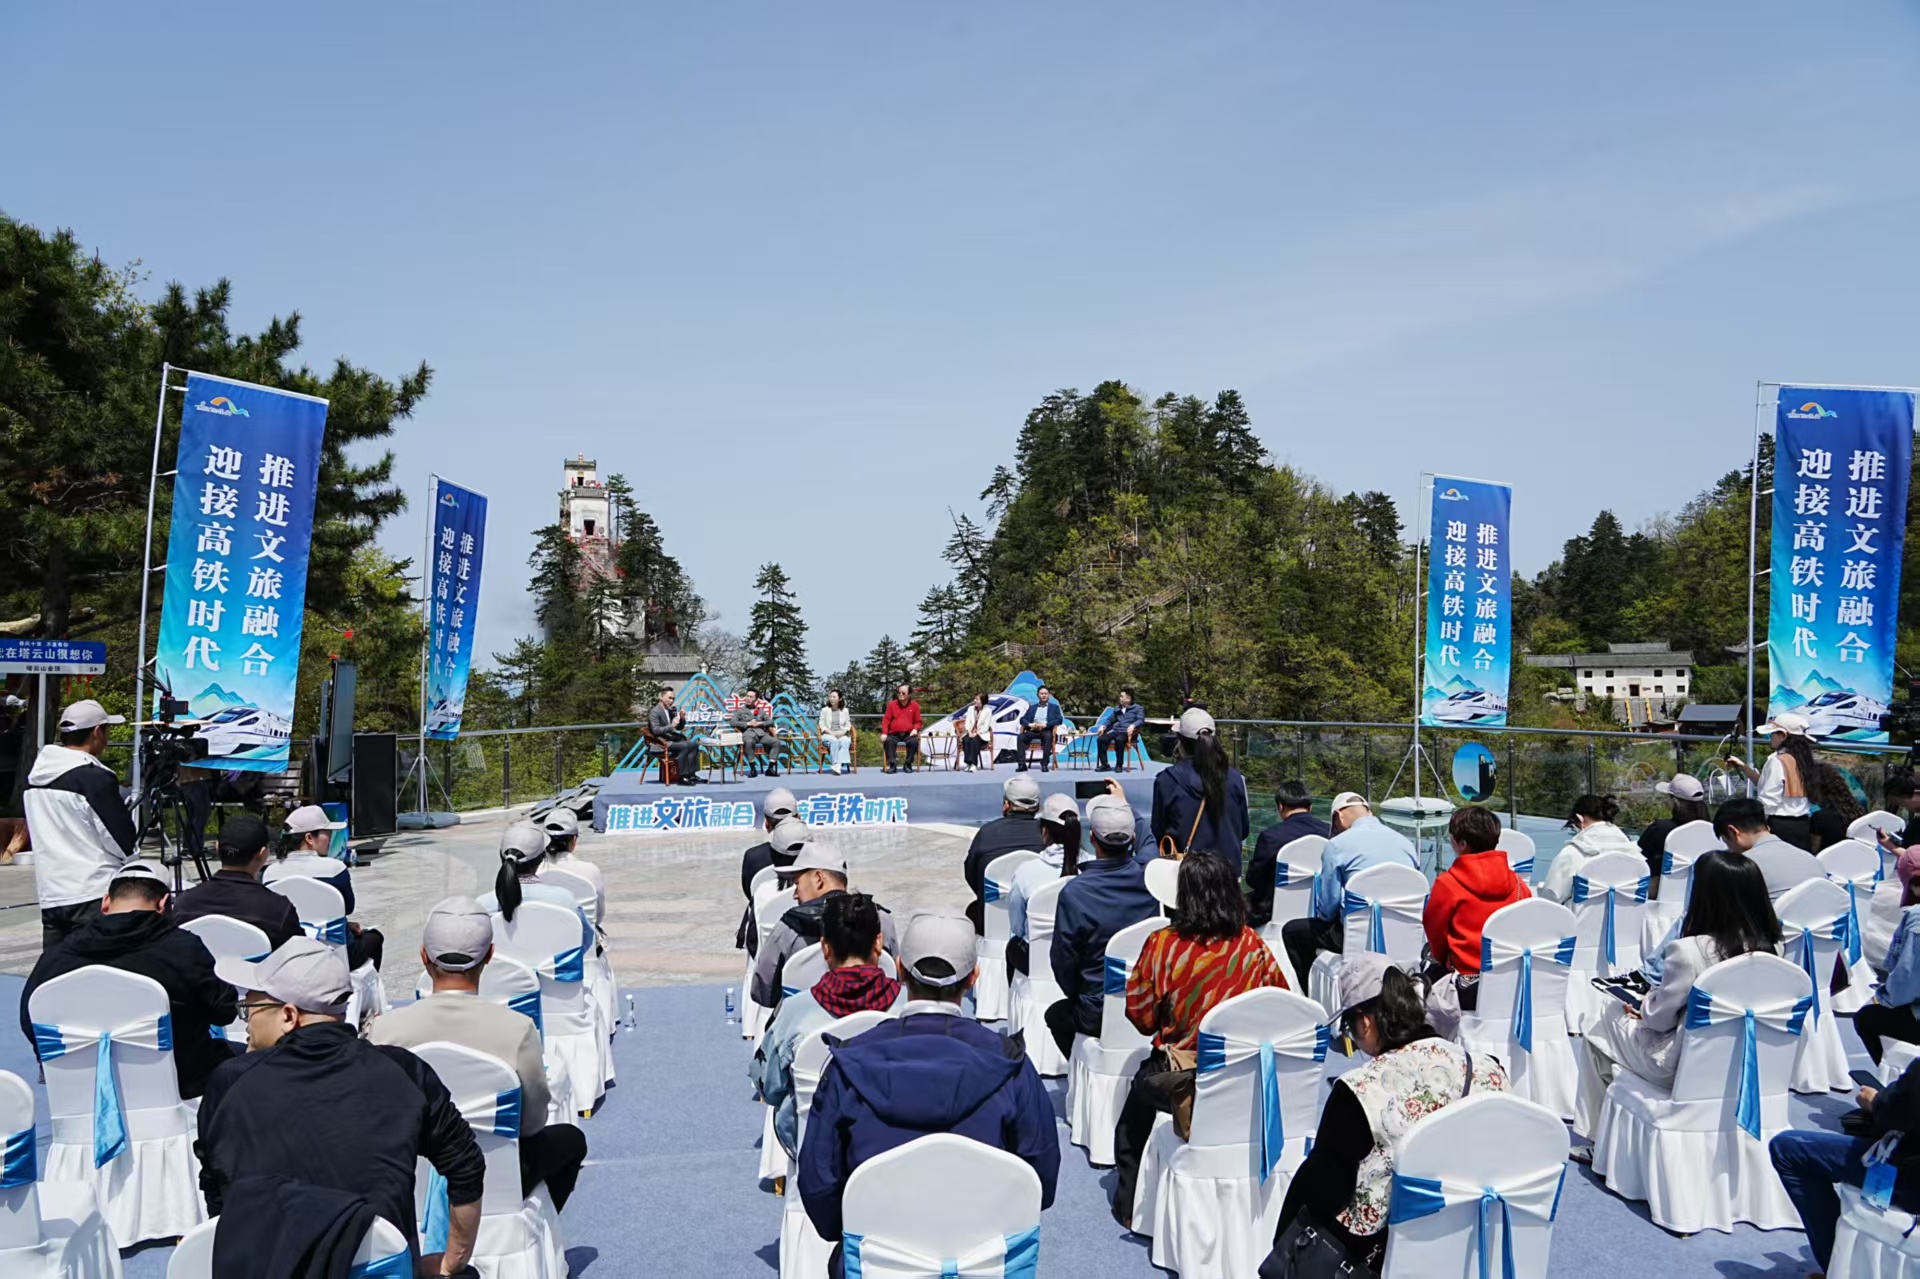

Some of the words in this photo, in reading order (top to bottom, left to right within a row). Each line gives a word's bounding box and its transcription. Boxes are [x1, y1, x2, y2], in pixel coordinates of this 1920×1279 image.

[183, 444, 243, 672] 迎接高铁时代
[239, 452, 296, 677] 推进文旅融合
[434, 526, 456, 676] 迎接高铁时代
[444, 532, 475, 678] 推进文旅融合
[1440, 519, 1467, 667] 迎接高铁时代
[1472, 522, 1499, 671] 推进文旅融合
[1790, 448, 1833, 659] 迎接高铁时代
[1835, 449, 1887, 663] 推进文旅融合
[608, 798, 754, 830] 推进文旅融合
[798, 794, 908, 826] 接高铁时代
